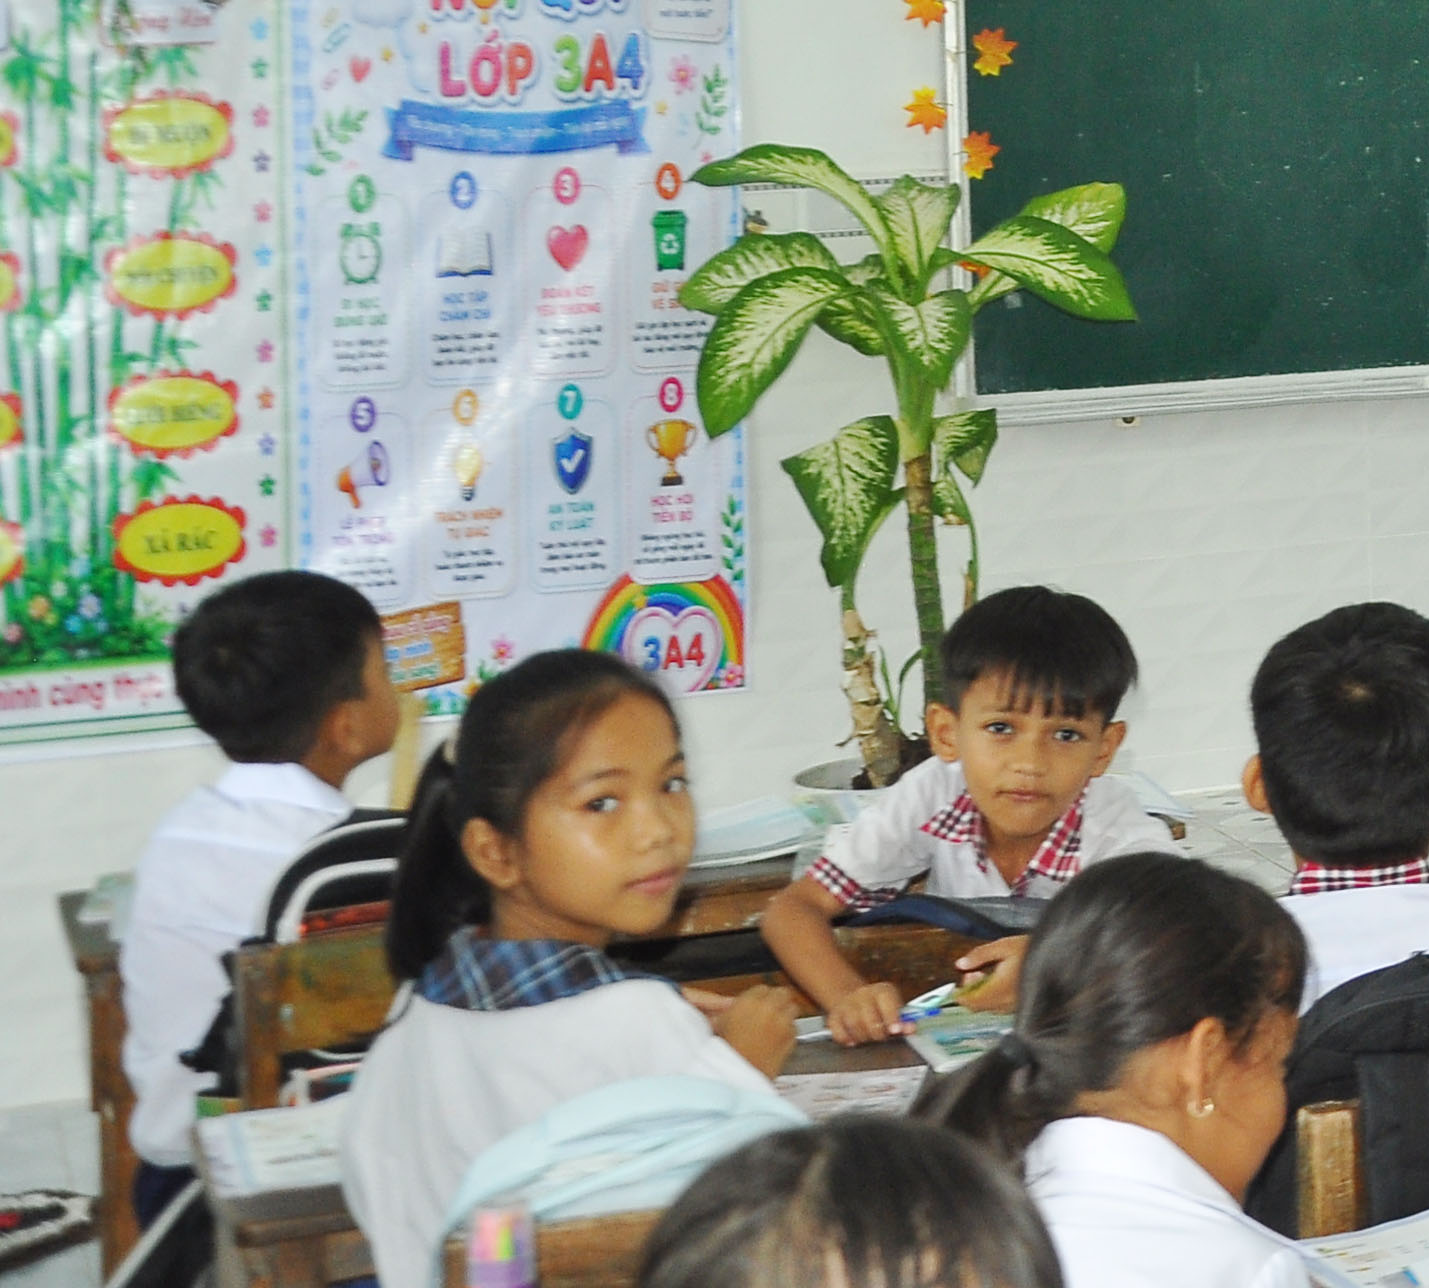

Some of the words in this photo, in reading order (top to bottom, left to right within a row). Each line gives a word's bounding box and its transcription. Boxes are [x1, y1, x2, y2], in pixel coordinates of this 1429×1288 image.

[438, 28, 535, 99] LỚP
[553, 31, 645, 95] 3A4
[643, 633, 706, 673] 3A4
